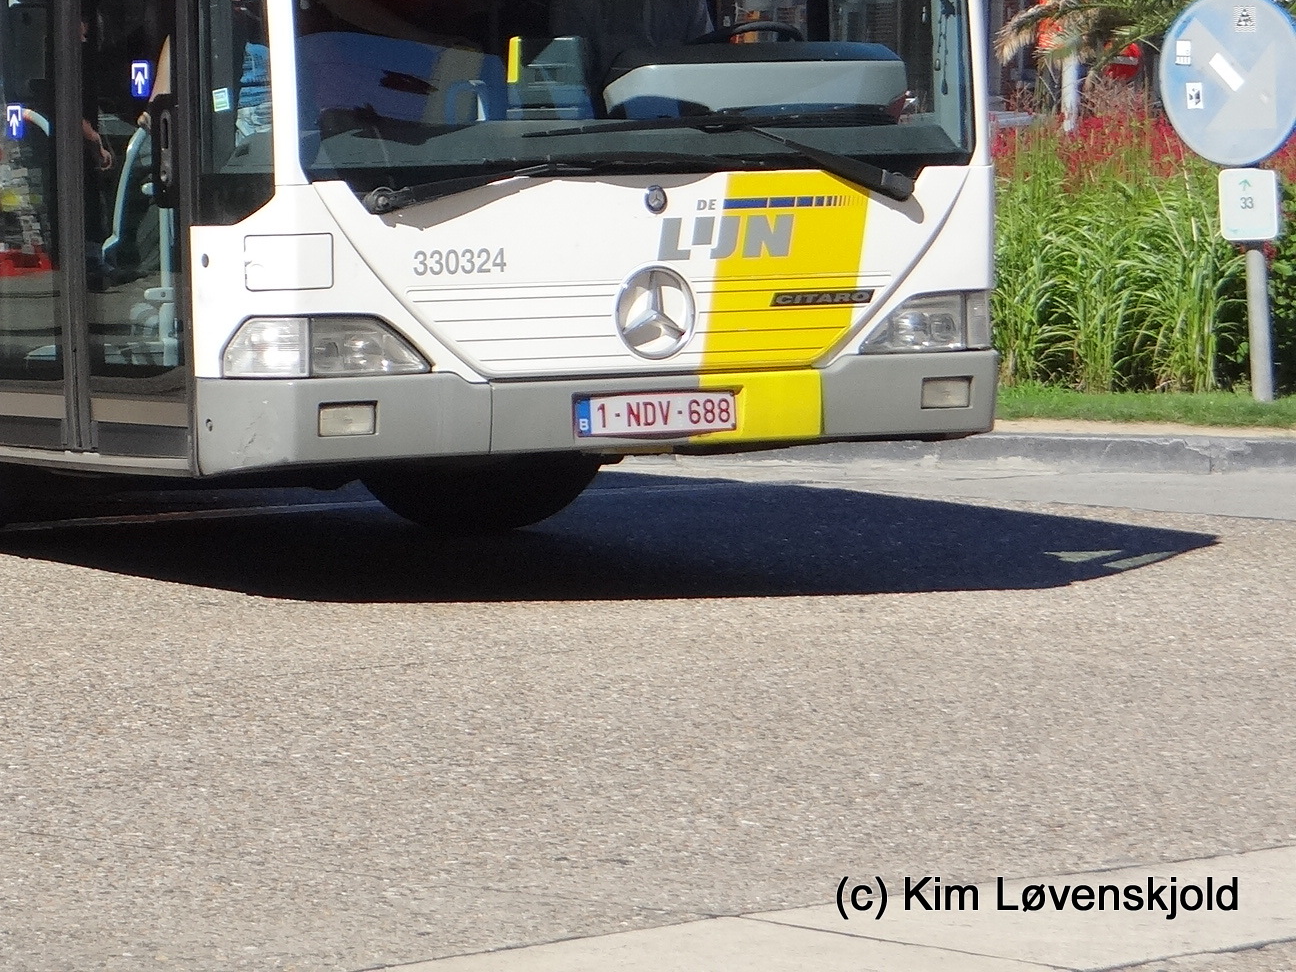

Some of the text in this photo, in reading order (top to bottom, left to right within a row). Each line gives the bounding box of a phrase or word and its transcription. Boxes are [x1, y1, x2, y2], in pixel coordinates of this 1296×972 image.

[696, 199, 717, 211] DE
[1240, 197, 1254, 210] 33
[657, 214, 795, 261] LIJN
[413, 247, 507, 276] 330324
[775, 290, 871, 305] CITARO
[578, 418, 589, 431] B
